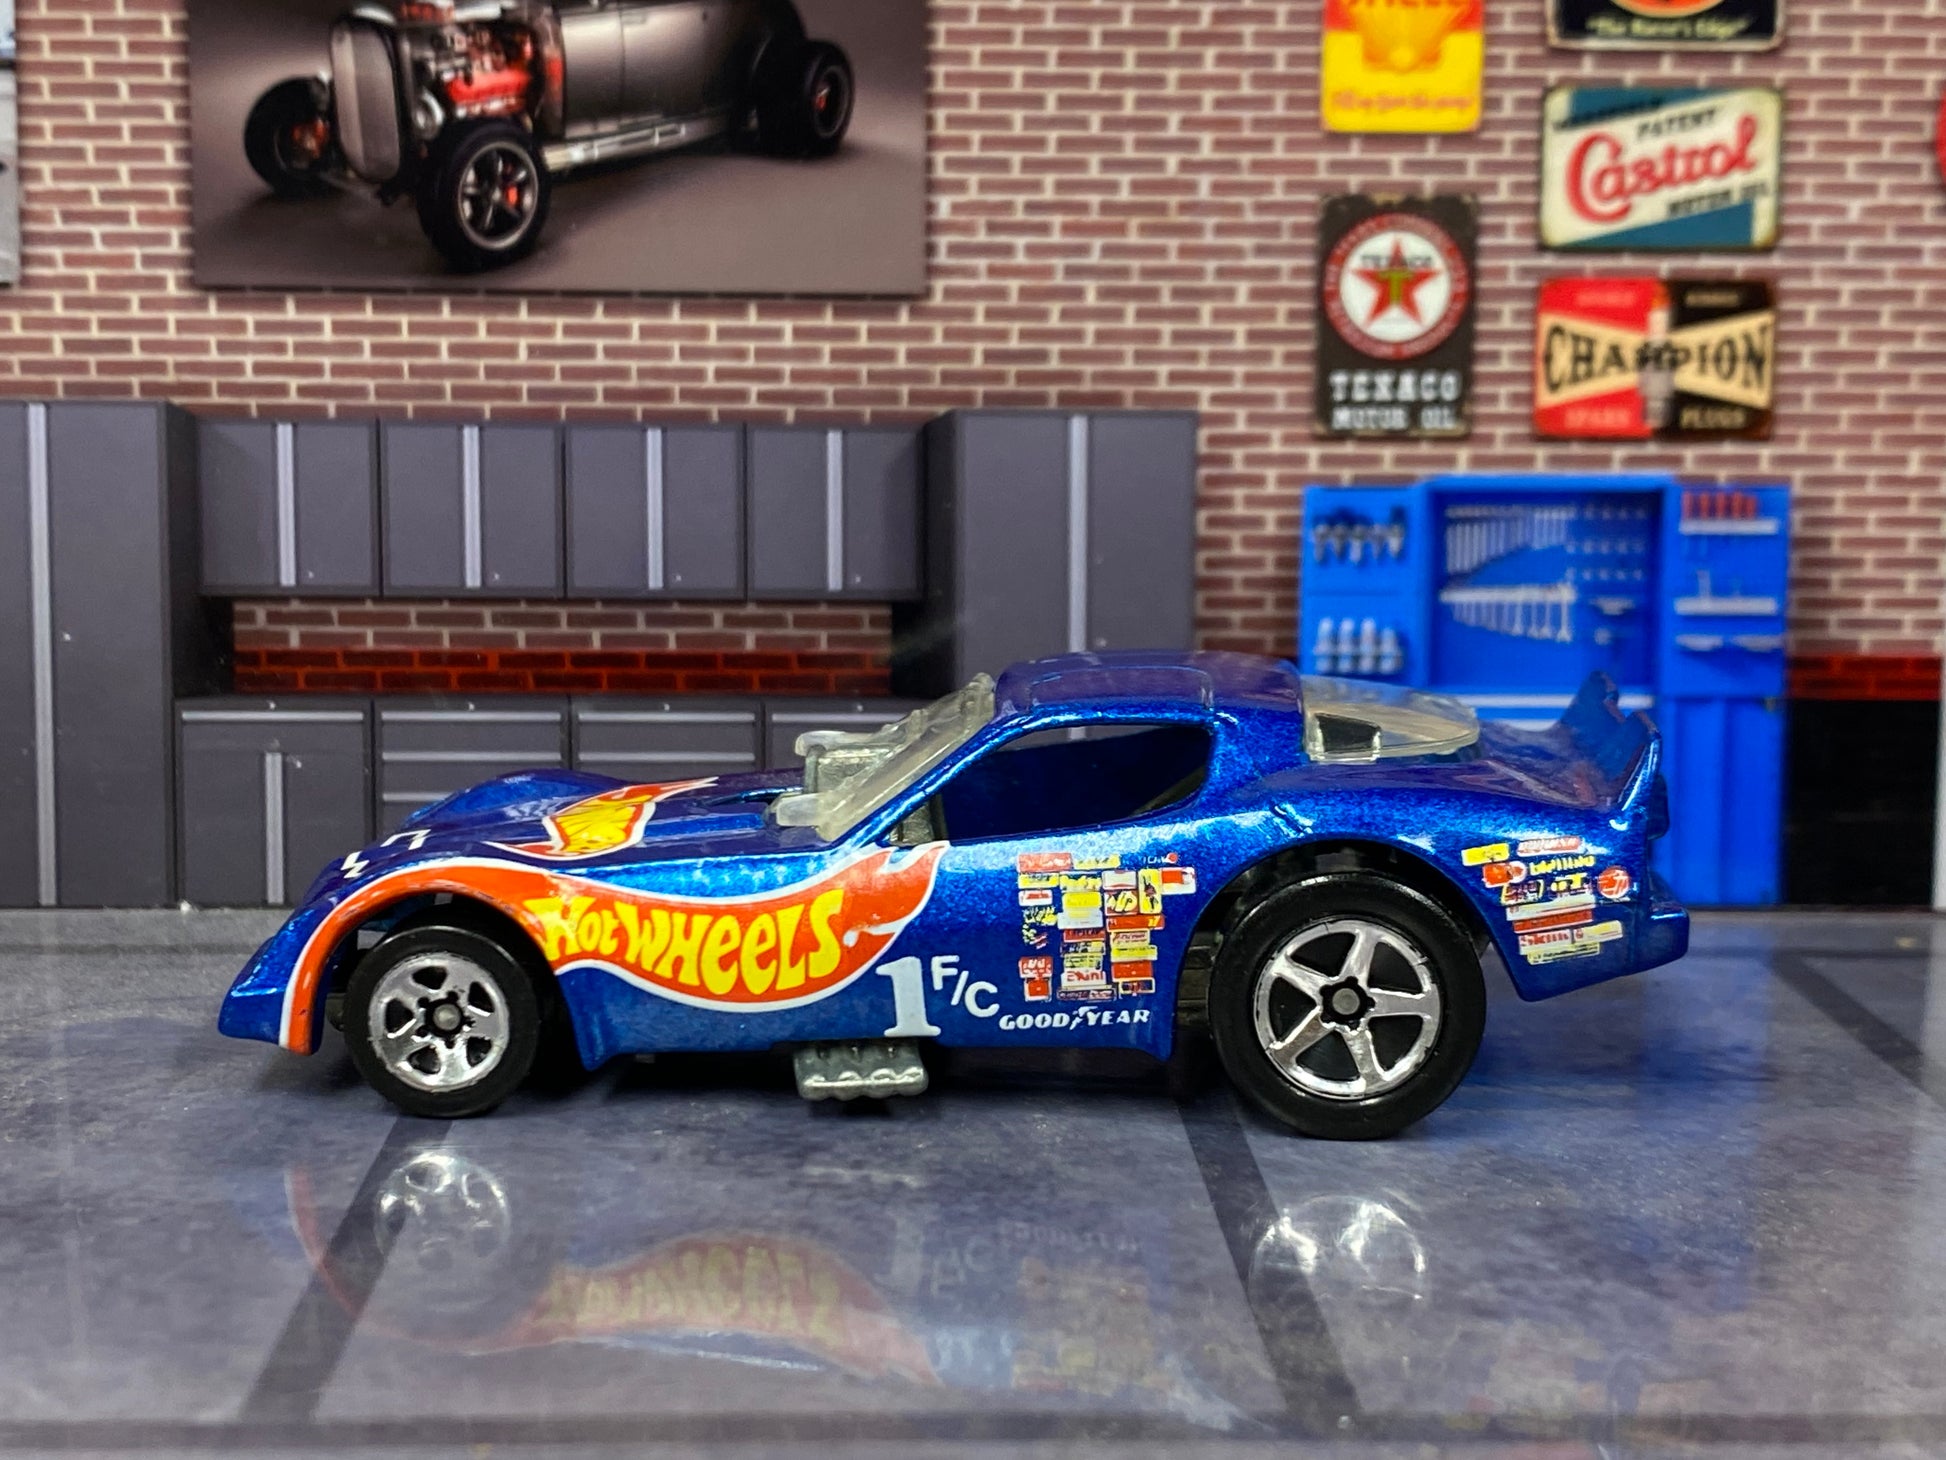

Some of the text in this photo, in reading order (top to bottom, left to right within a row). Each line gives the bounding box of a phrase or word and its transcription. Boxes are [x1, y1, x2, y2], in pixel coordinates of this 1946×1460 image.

[1565, 112, 1758, 225] Castrol
[1544, 322, 1771, 395] CHAMPION
[1329, 369, 1462, 402] TEXACO
[1331, 405, 1457, 430] MOTOR OIL
[875, 955, 1000, 1037] 1 F/C
[999, 1006, 1150, 1031] GOODYEAR
